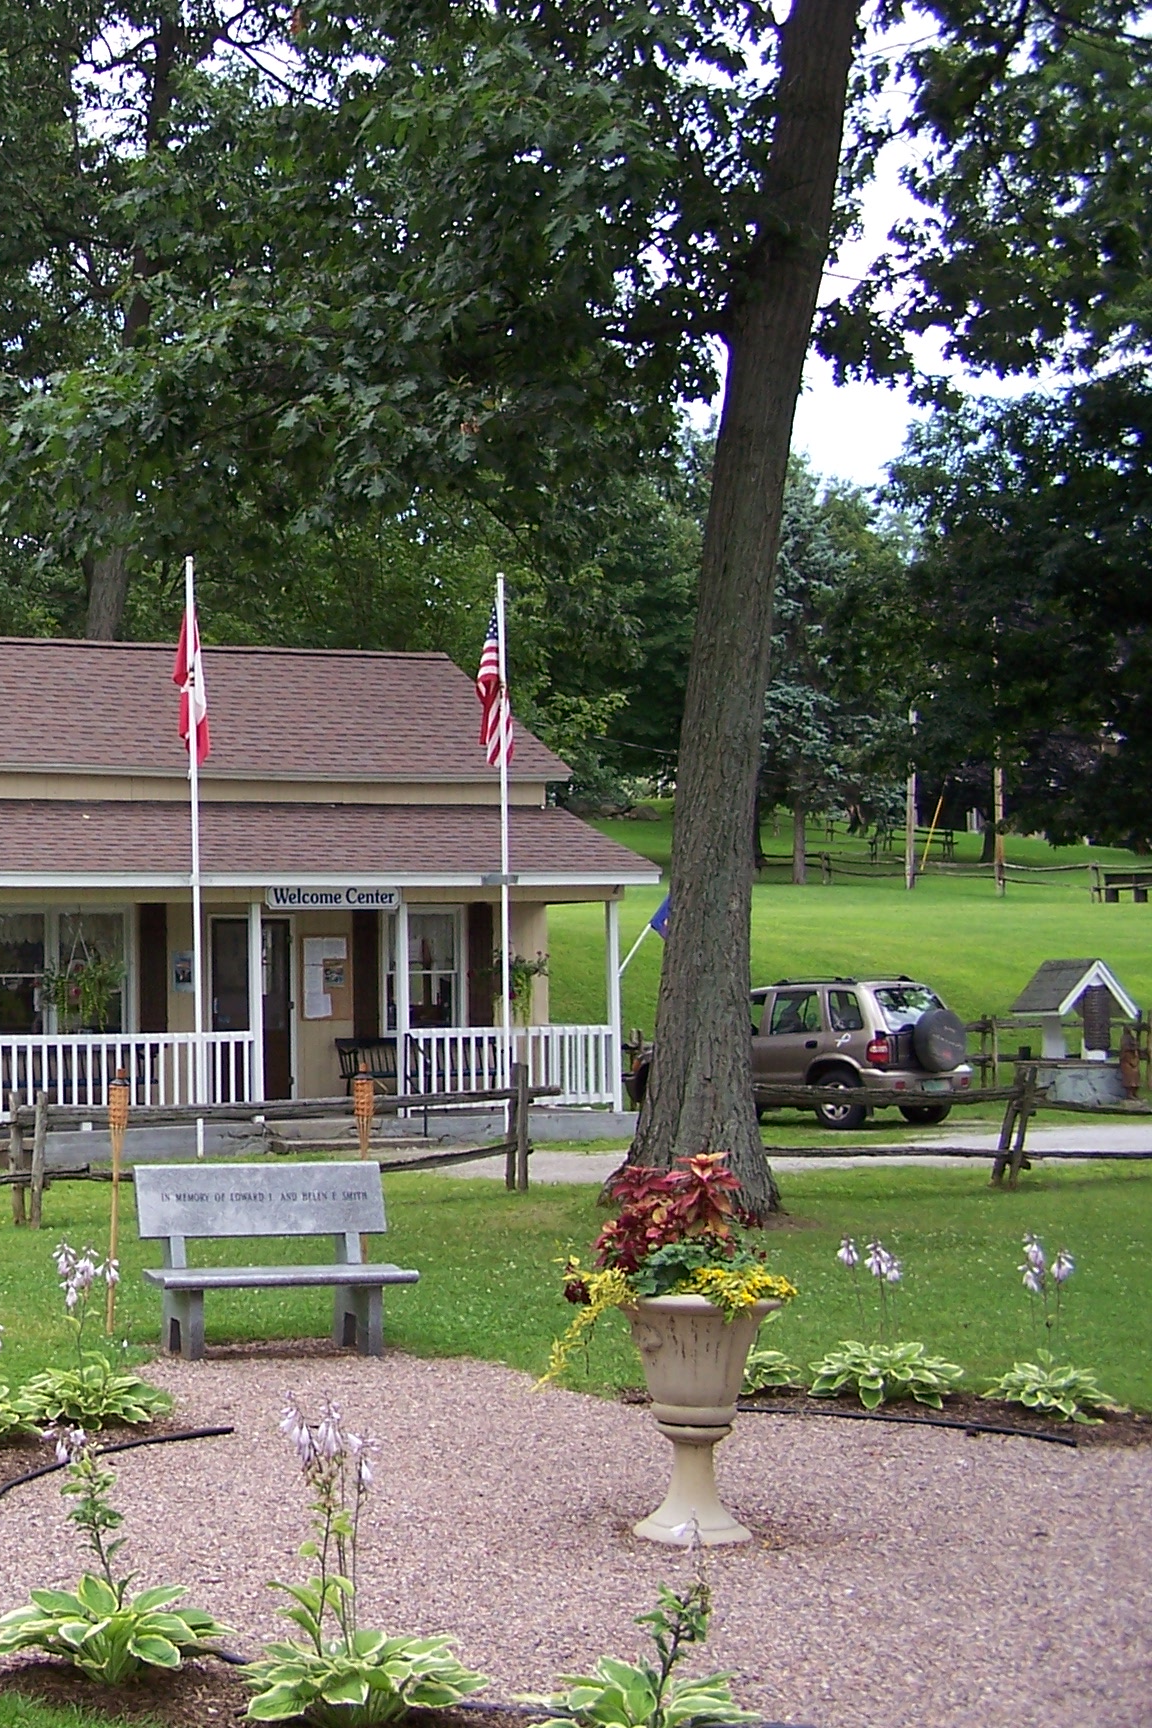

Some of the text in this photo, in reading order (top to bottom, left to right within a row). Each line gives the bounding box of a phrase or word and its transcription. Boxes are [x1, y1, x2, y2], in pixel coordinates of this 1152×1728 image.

[273, 887, 395, 904] Welcome Center
[161, 1193, 171, 1203] IN
[175, 1192, 209, 1203] MEMORY
[214, 1192, 226, 1203] OF
[229, 1192, 265, 1202] EDWARD
[280, 1192, 298, 1202] AND
[341, 1190, 368, 1201] SMITH
